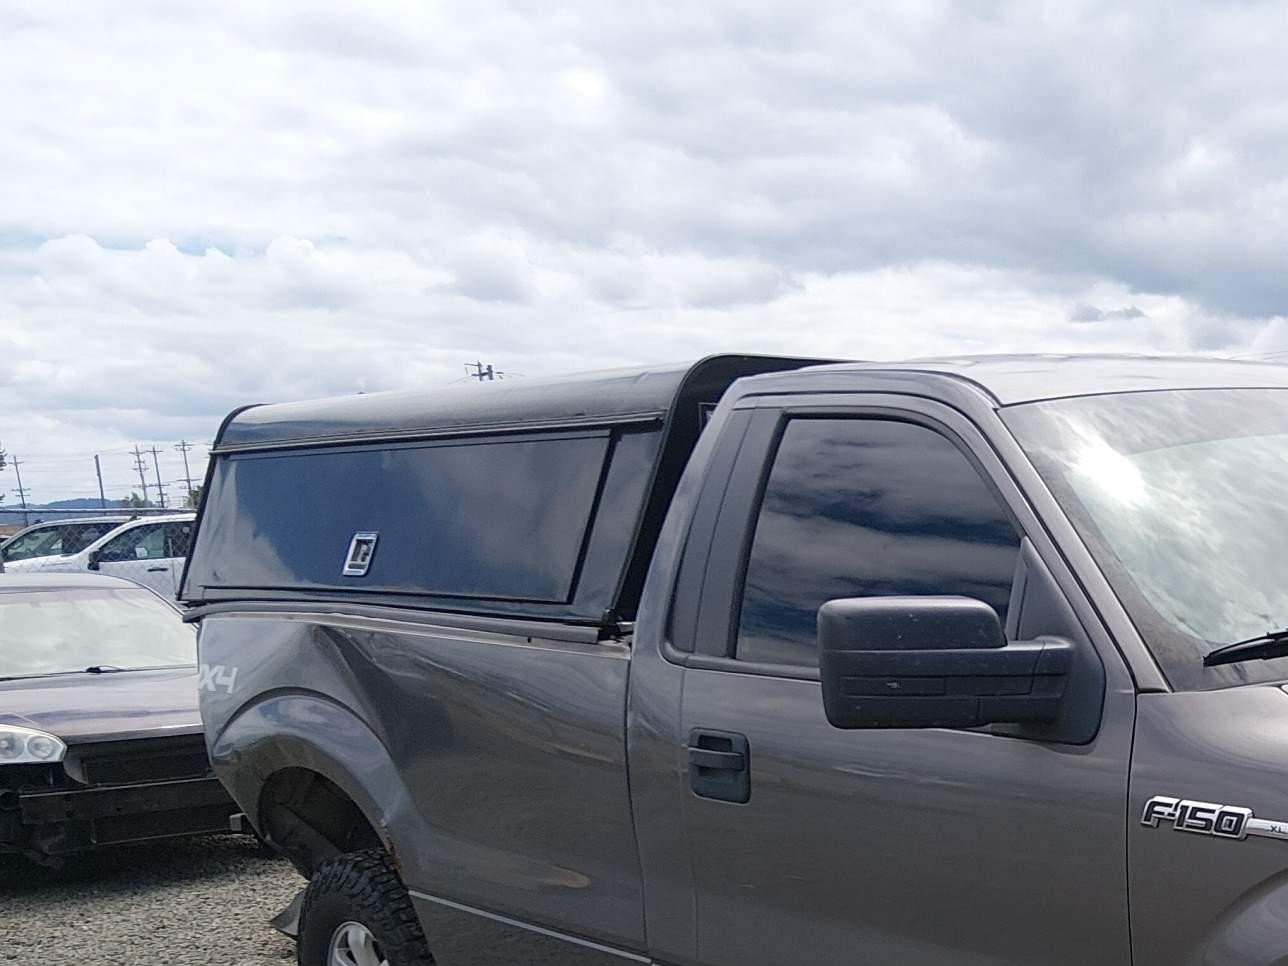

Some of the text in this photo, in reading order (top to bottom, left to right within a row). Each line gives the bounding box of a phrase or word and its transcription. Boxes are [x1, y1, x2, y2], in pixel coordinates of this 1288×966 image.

[200, 664, 238, 694] X4
[1142, 797, 1284, 840] F-150 XL
